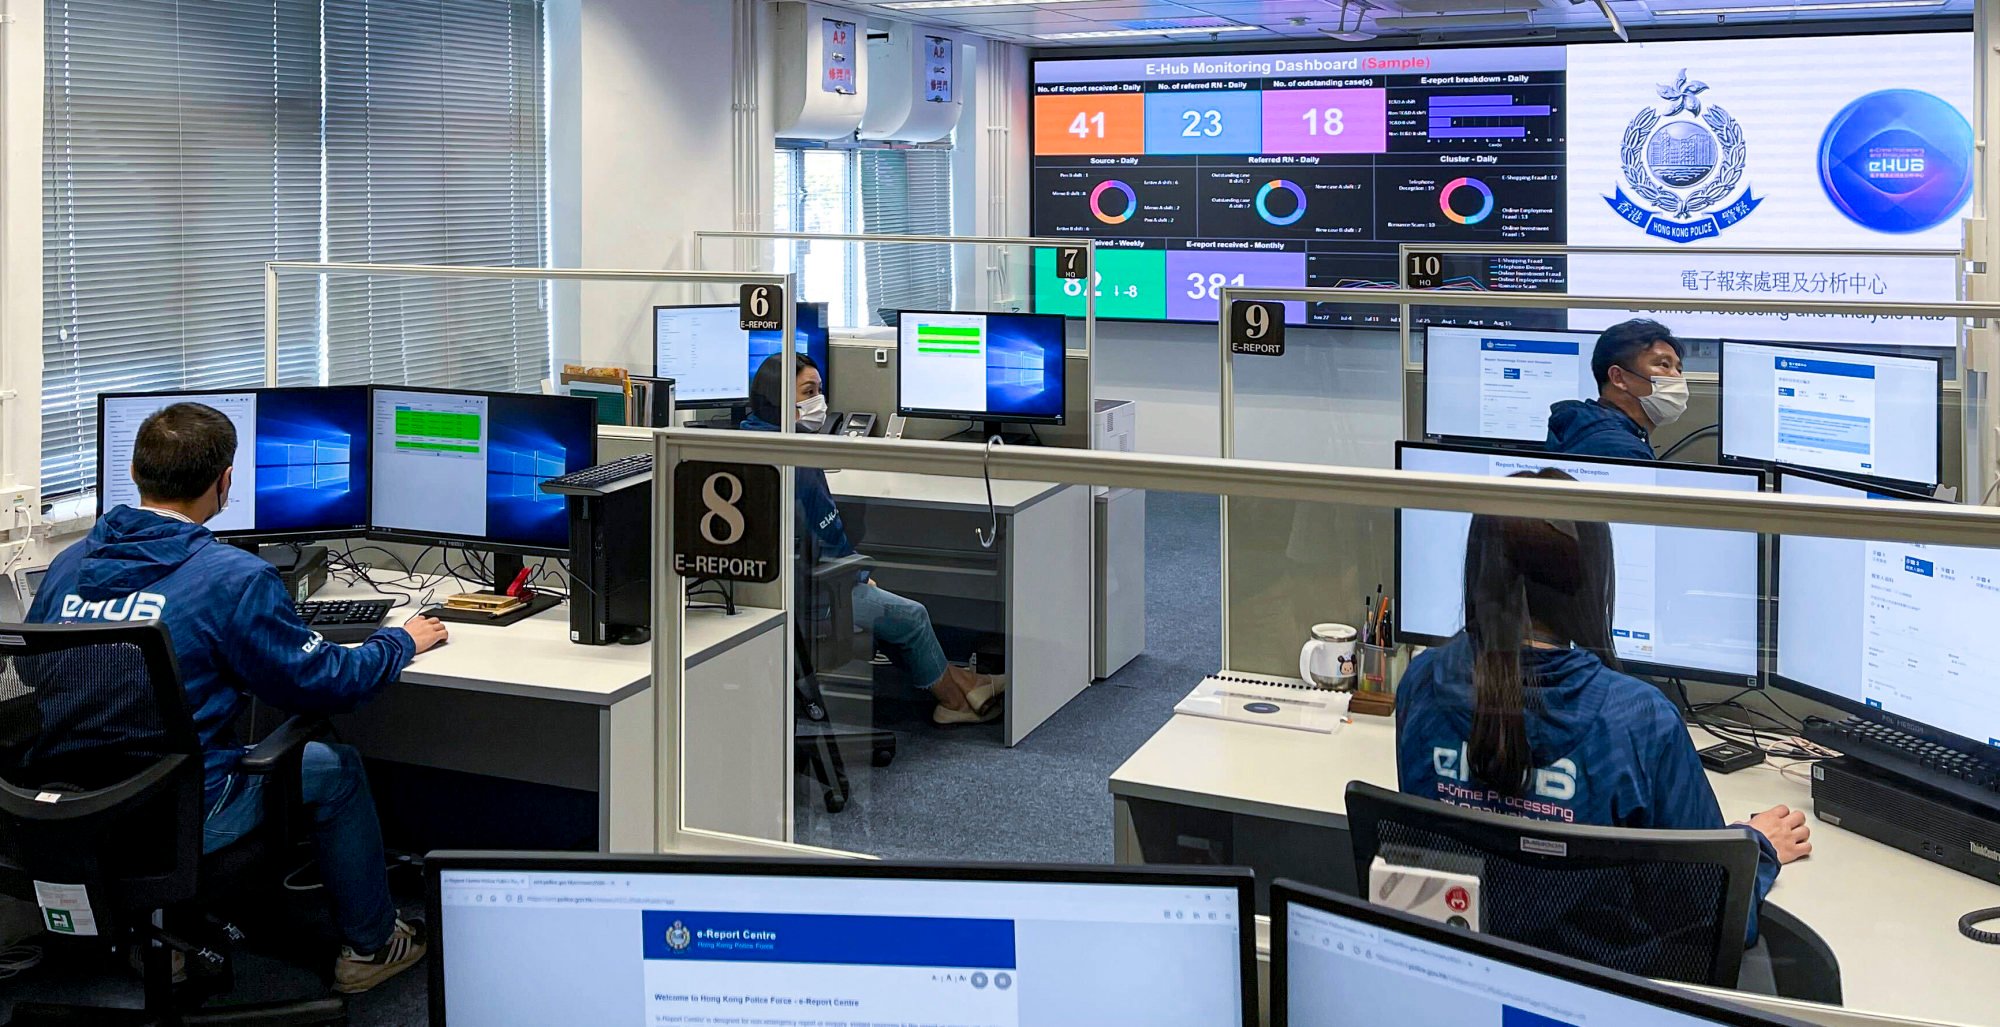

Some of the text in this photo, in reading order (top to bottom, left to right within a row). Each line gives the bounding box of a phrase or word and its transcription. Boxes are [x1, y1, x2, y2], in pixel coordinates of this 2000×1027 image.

[833, 31, 845, 44] A.P.
[1146, 57, 1430, 75] E-Hub Monitoring Dashboard (Sample)
[1297, 79, 1343, 88] outstanding
[1344, 78, 1373, 87] case(s)
[1421, 74, 1529, 85] E-report breakdown Daily
[1059, 85, 1087, 94] E-report
[1088, 84, 1118, 92] received
[1123, 84, 1141, 92] Daily
[1068, 112, 1105, 138] 41
[1182, 109, 1223, 137] 23
[1302, 108, 1344, 136] 18
[1120, 157, 1139, 165] Daily
[1300, 156, 1320, 164] Daily
[1869, 159, 1925, 171] eHUB
[1617, 201, 1643, 224] 香港
[1654, 222, 1712, 237] HONG KONG POLICE
[1119, 240, 1145, 248] Weekly
[1186, 241, 1216, 249] E-report
[1254, 242, 1285, 250] Monthly
[1064, 249, 1078, 270] 7
[1411, 256, 1440, 276] 10
[1680, 270, 1887, 295] 電子報案處理及分析中心
[1123, 286, 1138, 298] -8
[750, 287, 769, 317] 6
[741, 321, 779, 329] E-REPORT
[1246, 305, 1269, 339] 9
[1232, 343, 1281, 353] E-REPORT
[700, 472, 745, 545] 8
[675, 554, 767, 578] E-REPORT
[61, 592, 165, 622] eHUB
[1437, 782, 1483, 801] e-Crime
[697, 929, 777, 941] e-Report Centre
[701, 995, 721, 1004] Hong
[723, 996, 743, 1005] Kong
[745, 996, 768, 1004] Police
[771, 997, 792, 1005] Force
[799, 998, 832, 1007] e-Report
